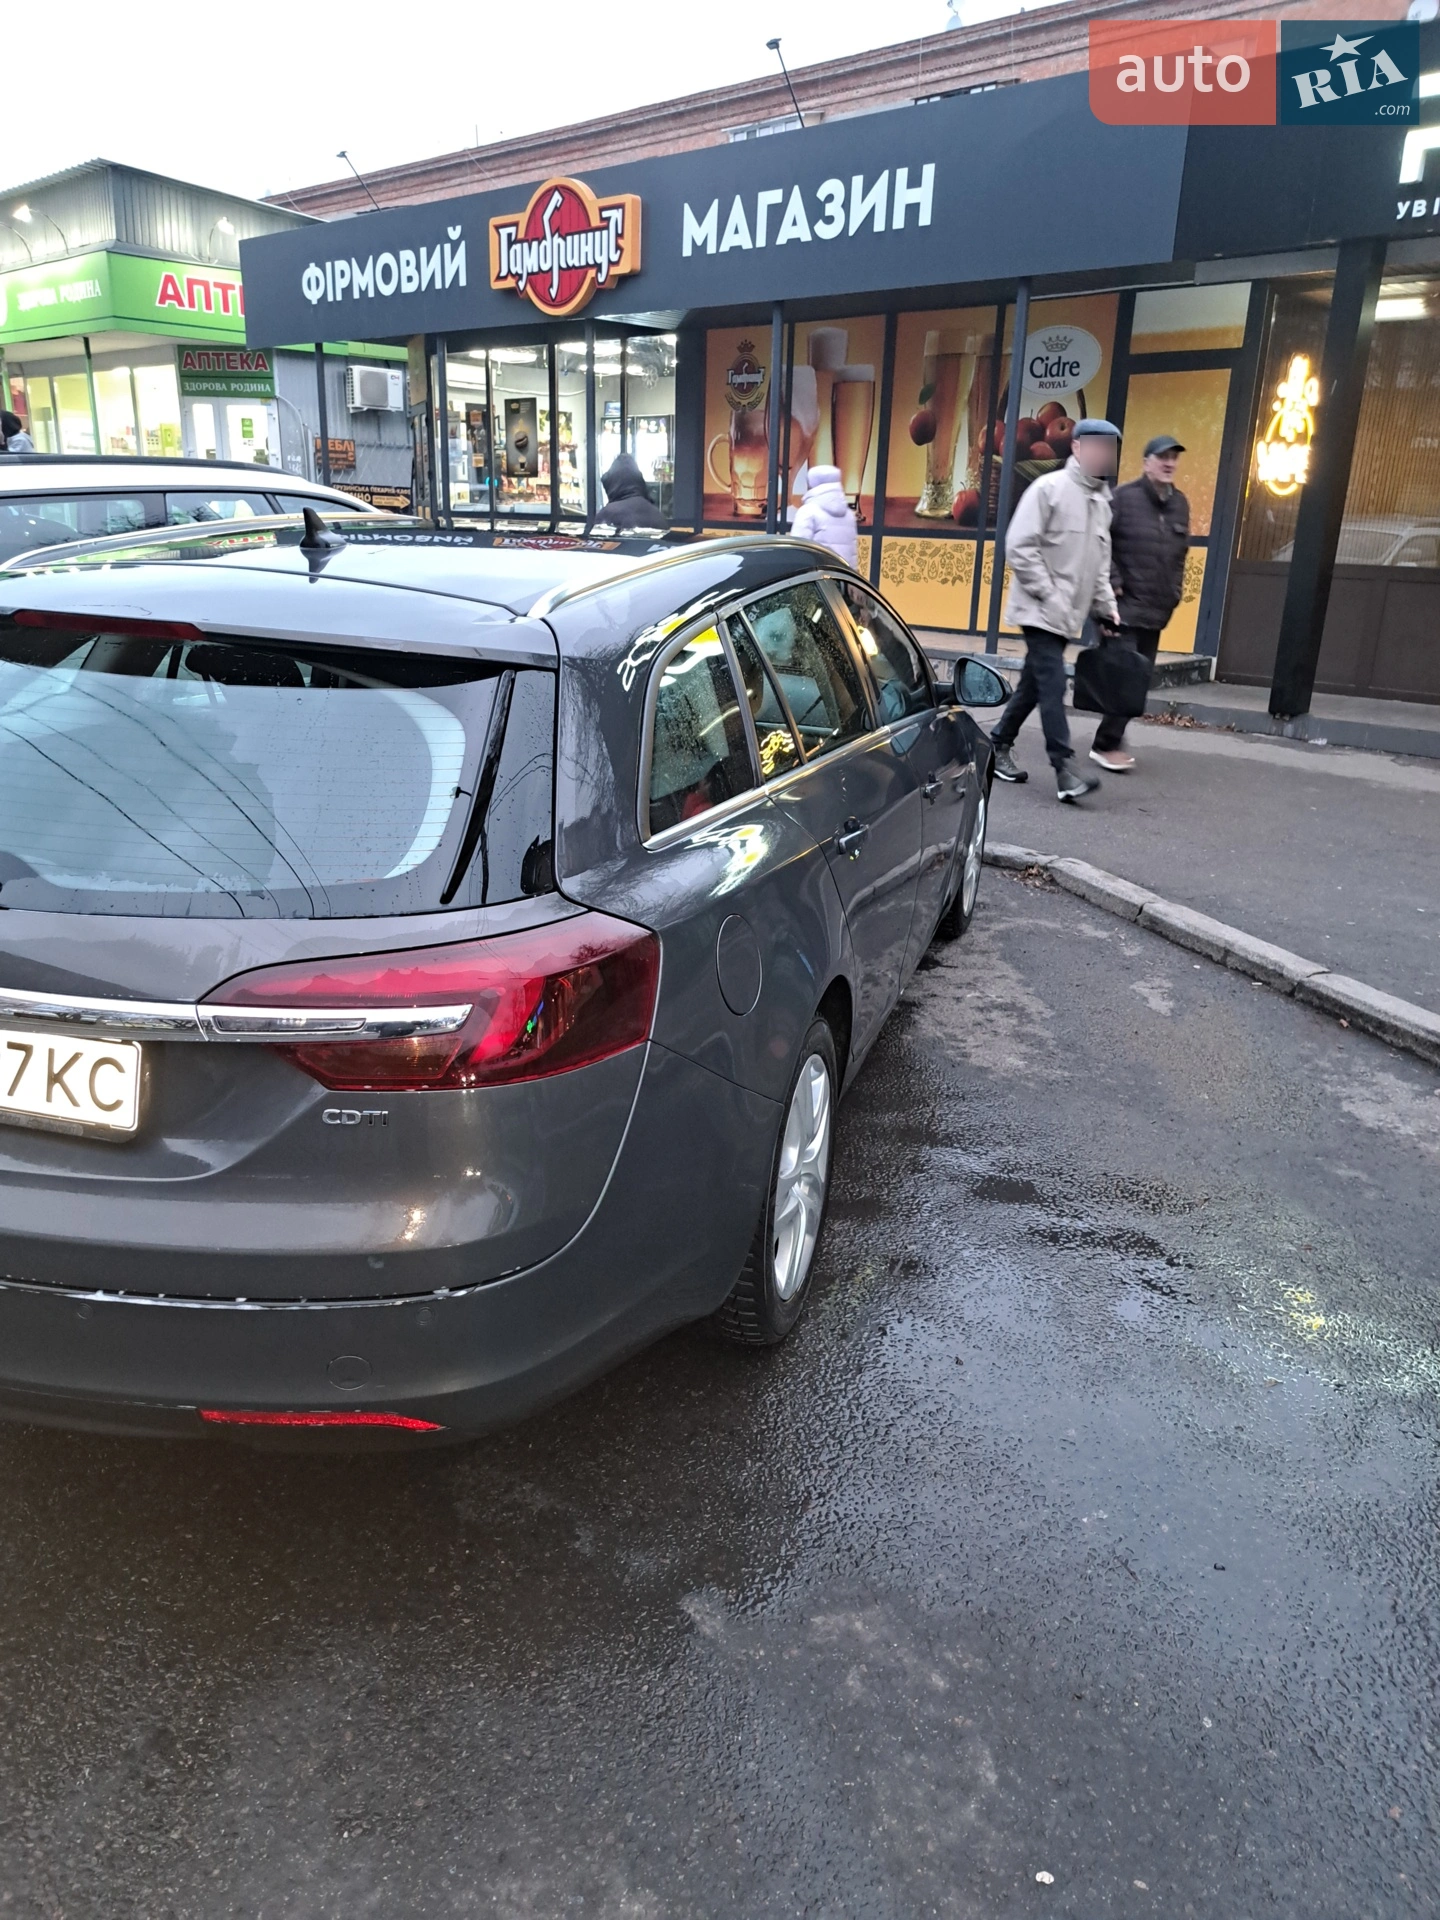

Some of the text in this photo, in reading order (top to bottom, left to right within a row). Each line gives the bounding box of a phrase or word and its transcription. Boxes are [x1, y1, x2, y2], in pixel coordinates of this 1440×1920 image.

[682, 163, 936, 258] МАГАЗИН
[302, 225, 467, 305] ФІРМОВИЙ
[156, 272, 245, 316] АПТ
[182, 351, 270, 371] АПТЕКА
[1029, 356, 1081, 379] Cidre
[183, 382, 271, 392] ЗДОРОВА РОДИНА
[1038, 380, 1069, 389] ROYAL
[322, 1108, 389, 1126] CDTI
